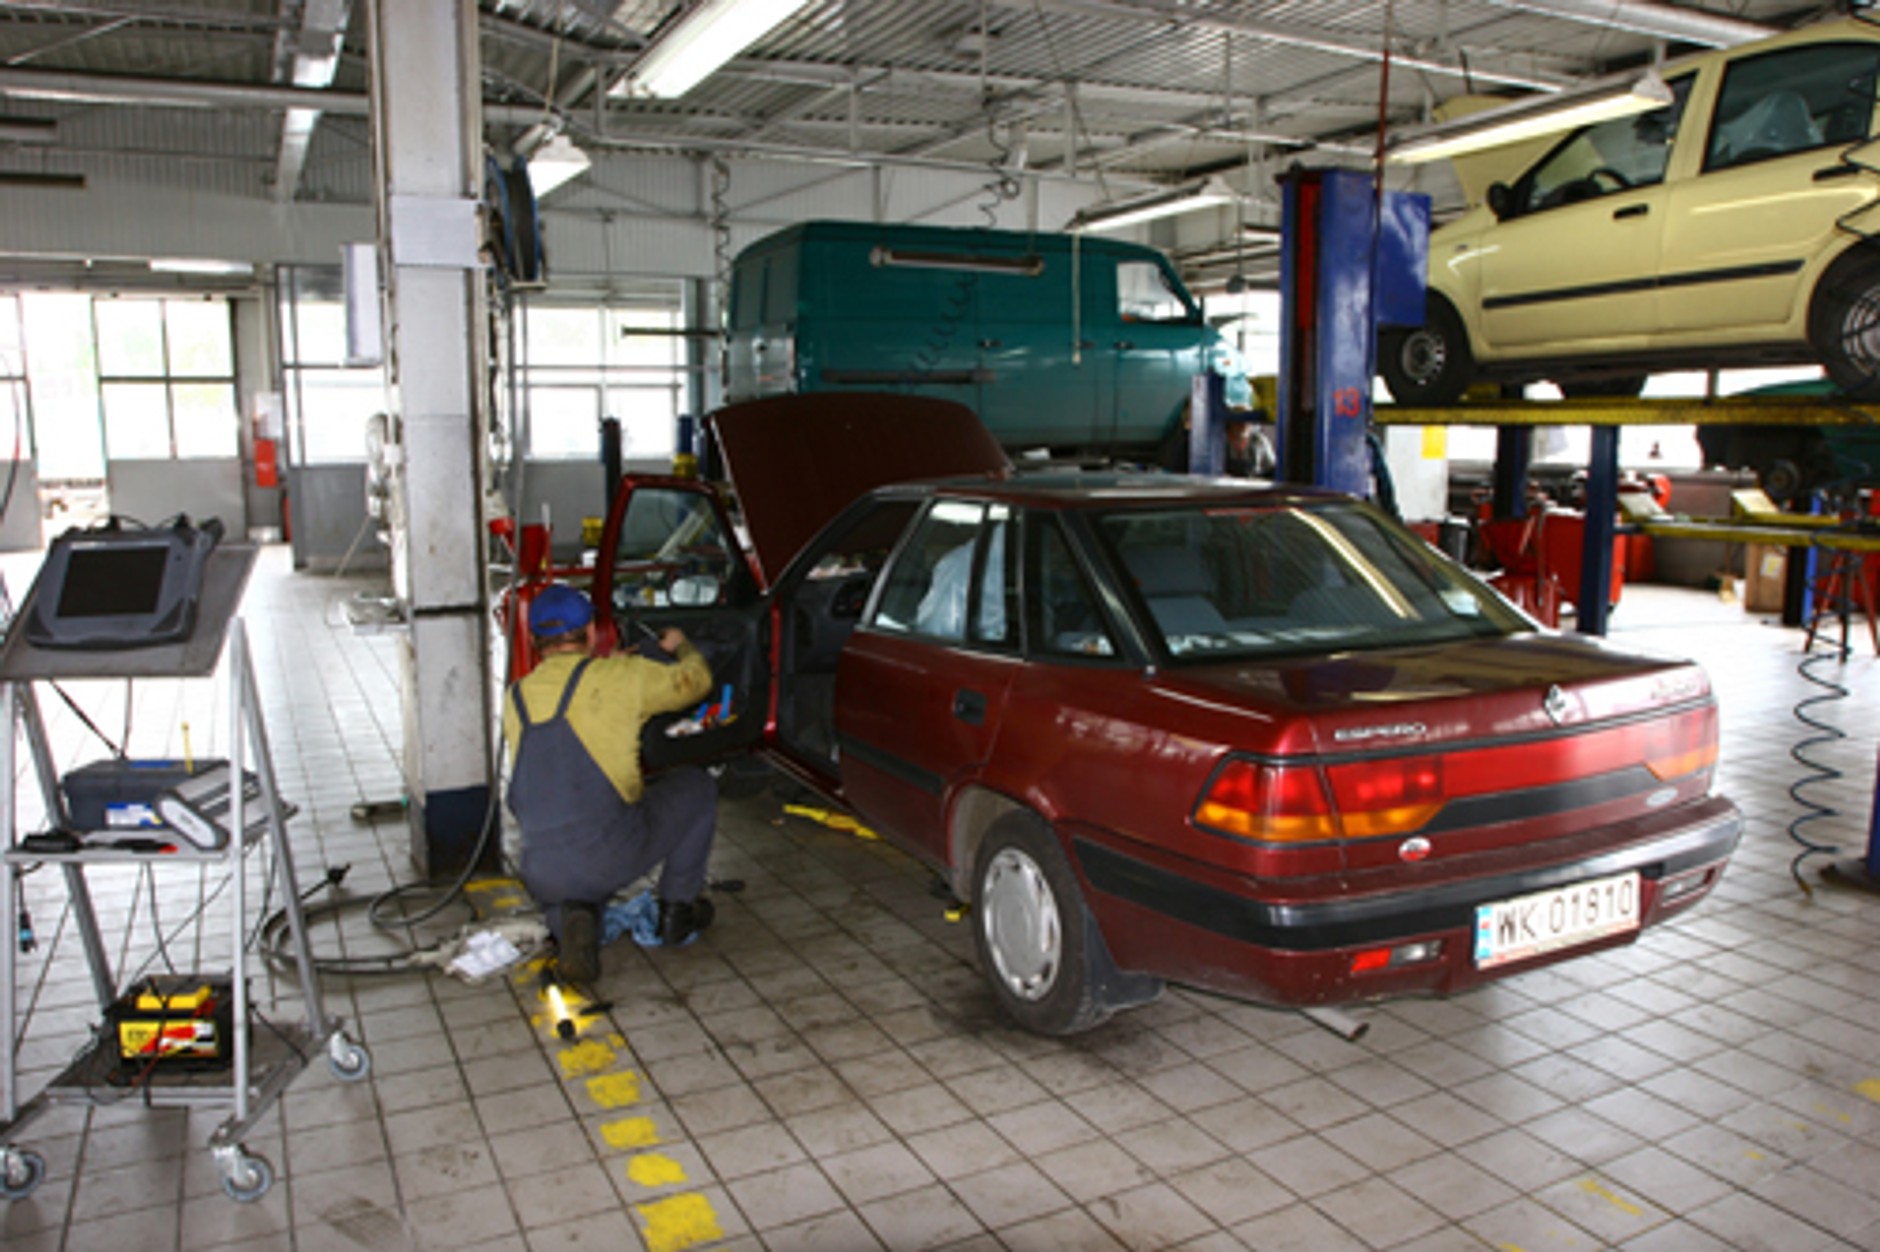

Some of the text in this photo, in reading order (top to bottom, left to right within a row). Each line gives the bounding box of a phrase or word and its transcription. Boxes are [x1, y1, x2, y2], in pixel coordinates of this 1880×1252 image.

[1332, 386, 1360, 418] 13
[1334, 722, 1427, 741] ESPERO
[1497, 878, 1634, 946] WK 01810
